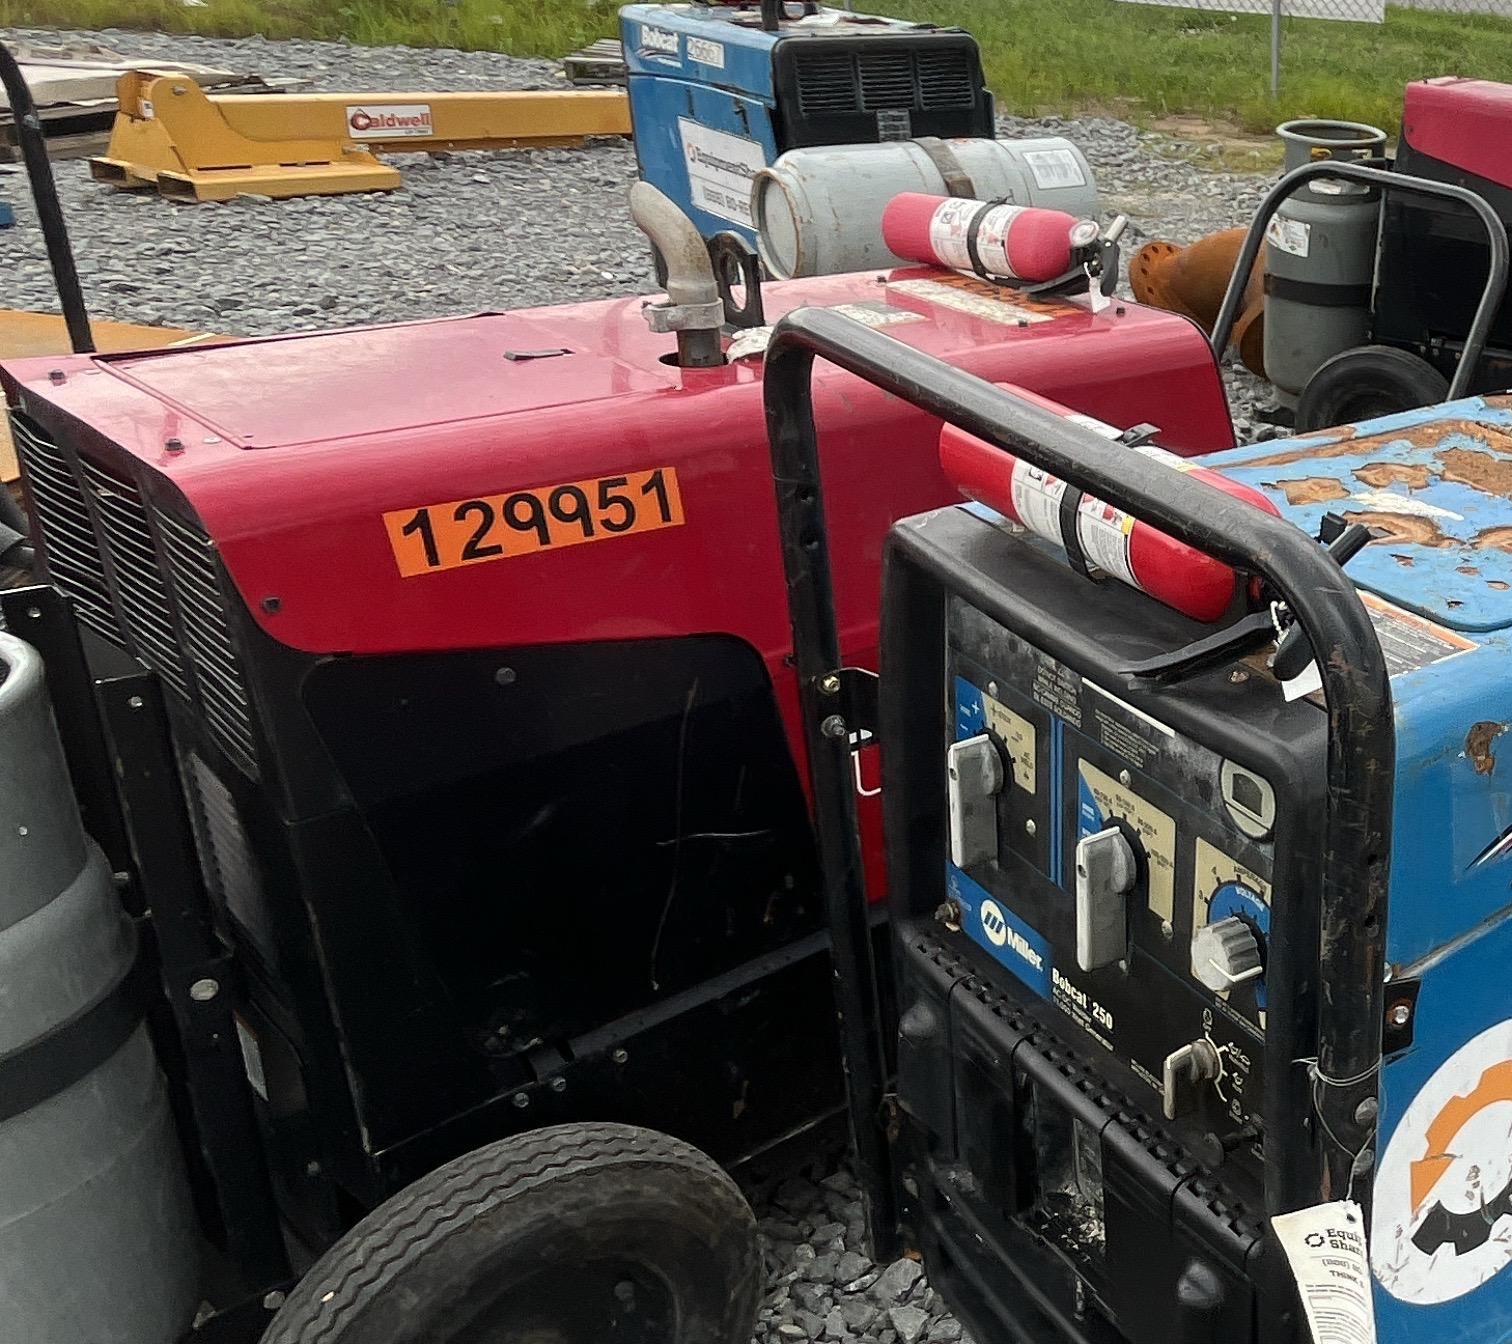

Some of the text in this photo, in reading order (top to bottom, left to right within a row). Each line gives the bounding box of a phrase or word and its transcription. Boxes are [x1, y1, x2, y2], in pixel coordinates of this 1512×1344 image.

[351, 112, 431, 130] Caldwell
[402, 469, 672, 567] 129951
[1006, 926, 1044, 971] Miller
[1052, 967, 1113, 1030] Bobcat 250
